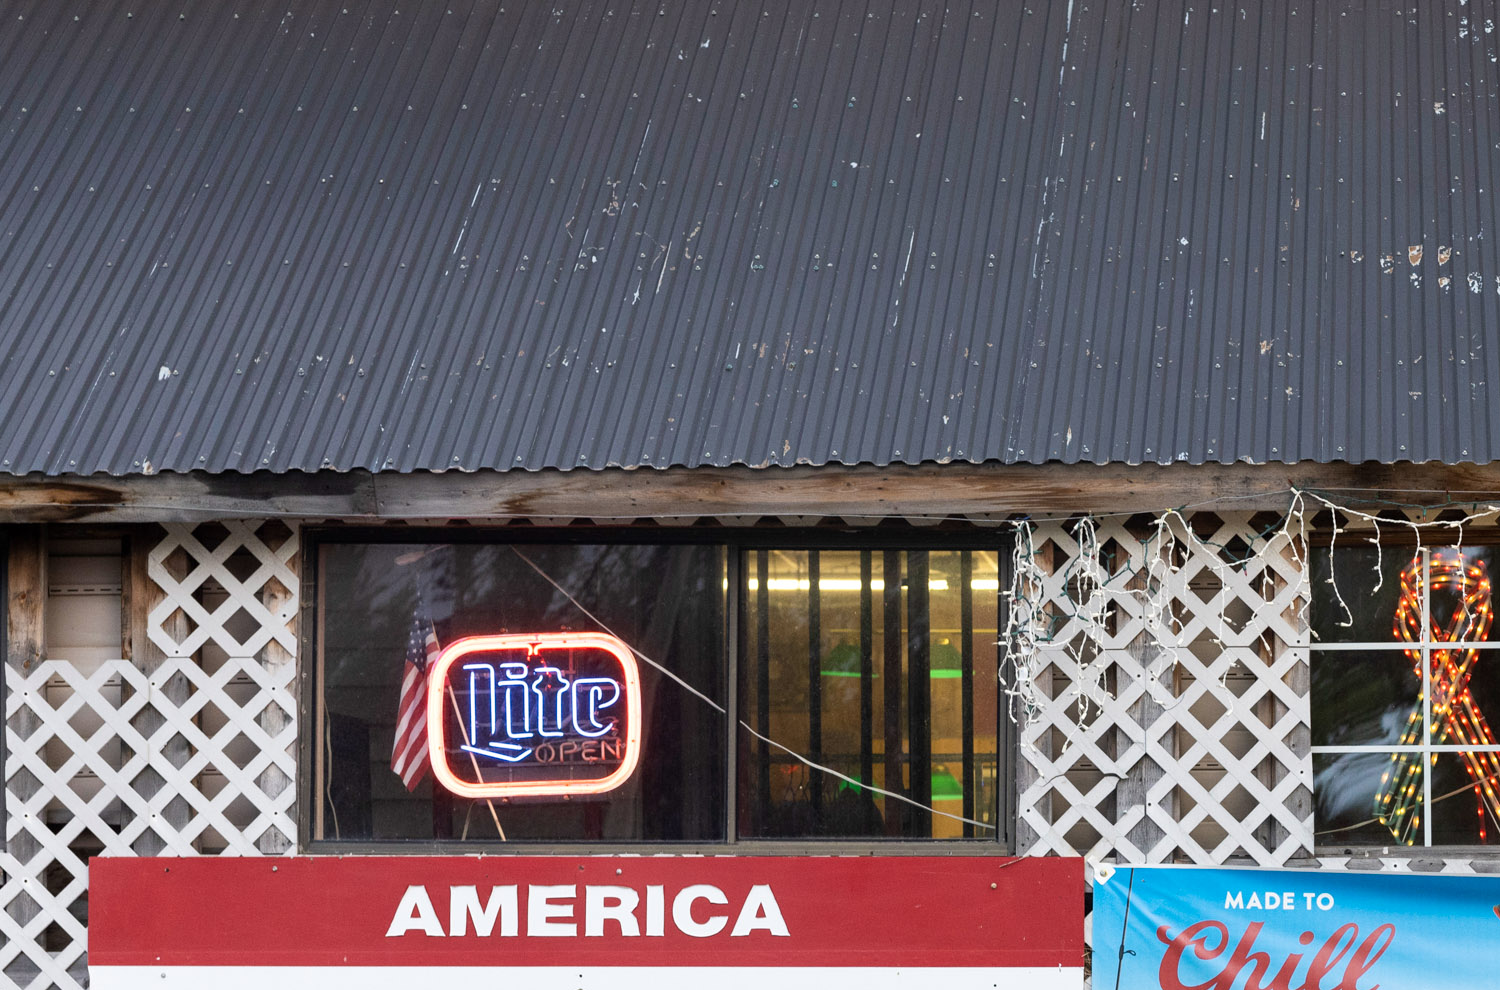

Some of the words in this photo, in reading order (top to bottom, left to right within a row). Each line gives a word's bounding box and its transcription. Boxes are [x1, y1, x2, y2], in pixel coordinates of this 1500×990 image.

[462, 662, 620, 746] Lite
[535, 738, 622, 764] OPEN
[386, 884, 791, 938] AMERICA
[1224, 891, 1295, 911] MADE
[1303, 892, 1334, 911] TO
